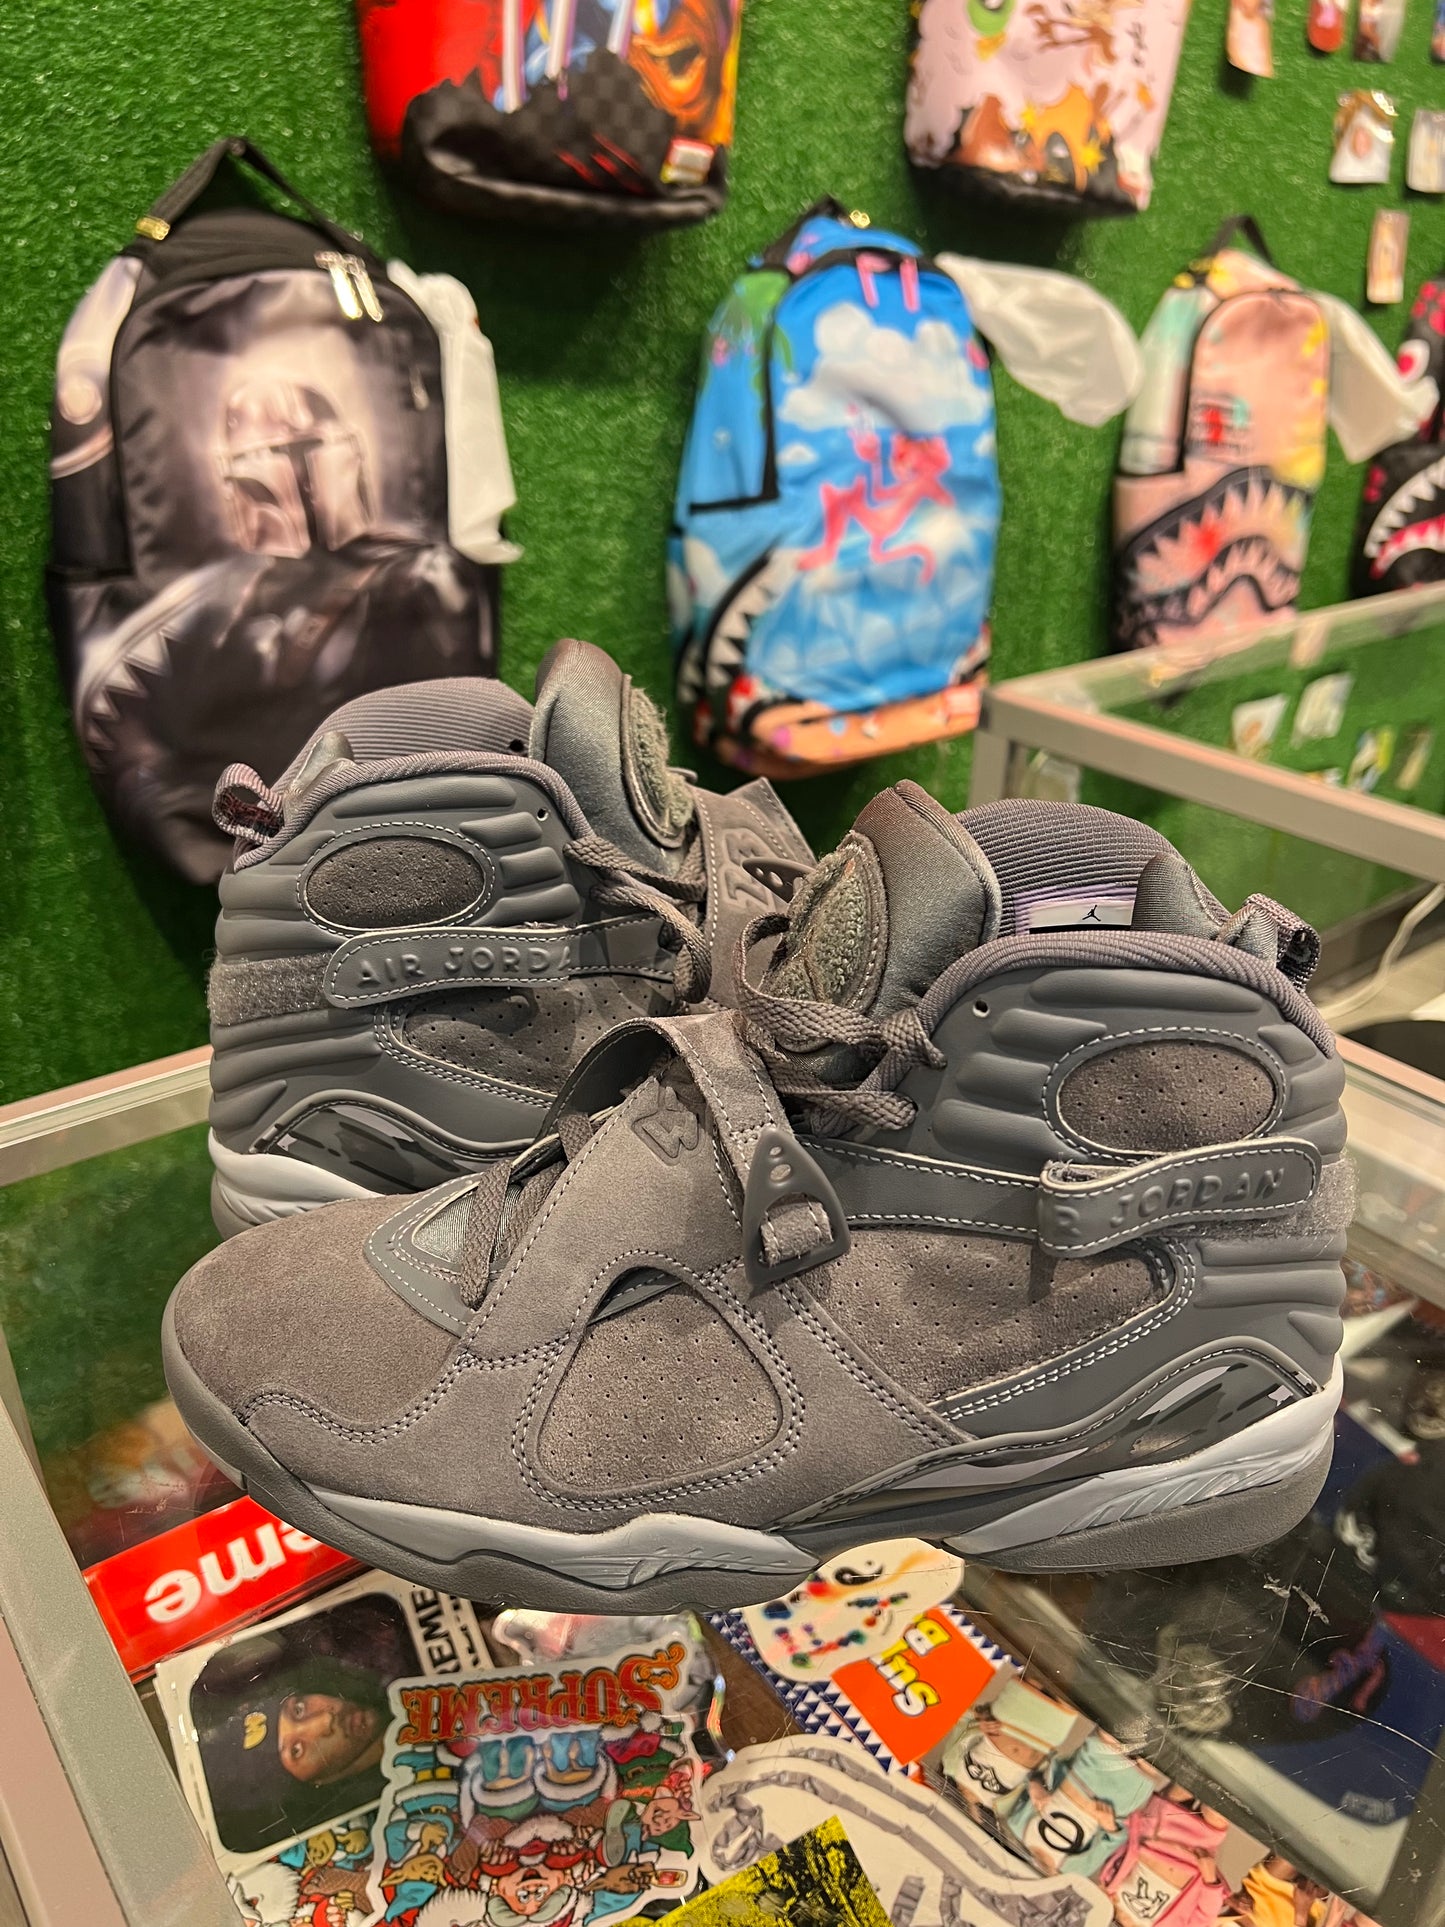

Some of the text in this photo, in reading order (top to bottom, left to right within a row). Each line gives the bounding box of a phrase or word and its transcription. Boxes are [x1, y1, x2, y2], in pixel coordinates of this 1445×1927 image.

[357, 953, 425, 988] AIR
[1109, 1167, 1286, 1229] JORDAN
[397, 1641, 686, 1745] SUPREME
